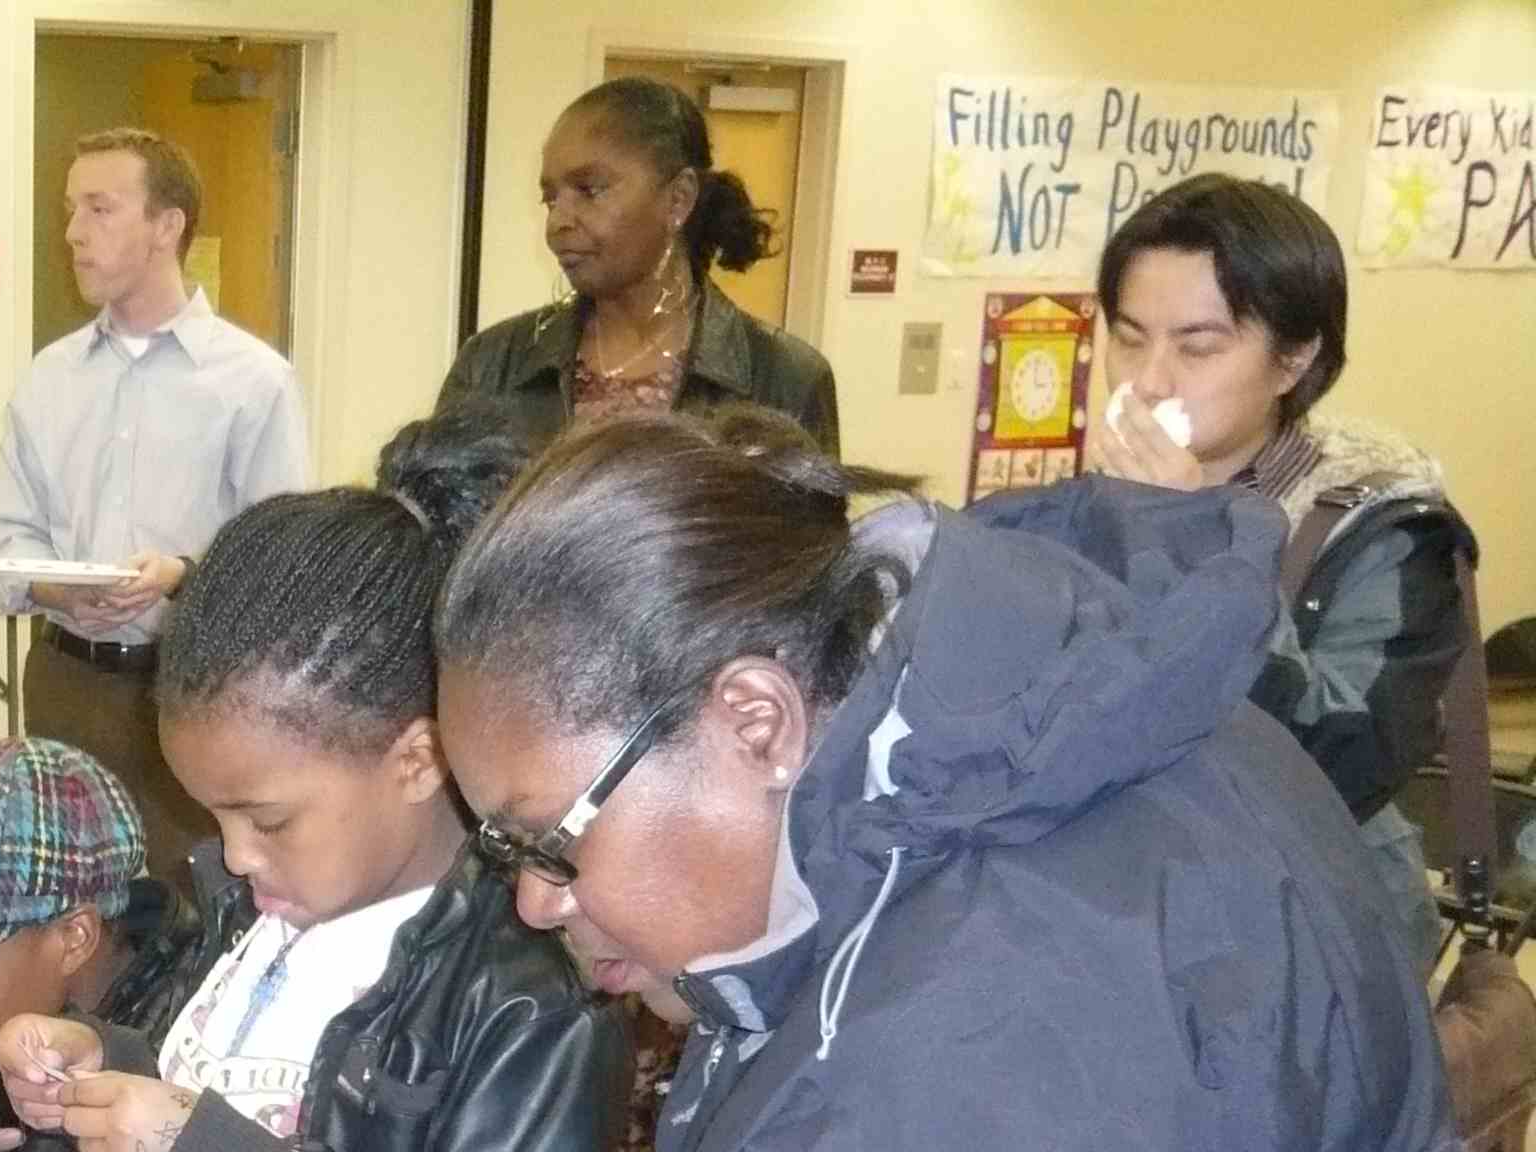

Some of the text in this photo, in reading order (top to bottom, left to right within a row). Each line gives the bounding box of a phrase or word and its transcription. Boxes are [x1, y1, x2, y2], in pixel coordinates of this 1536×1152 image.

[948, 86, 1318, 176] Filling Playgrounds
[1375, 94, 1472, 166] Every
[990, 162, 1081, 256] NOT
